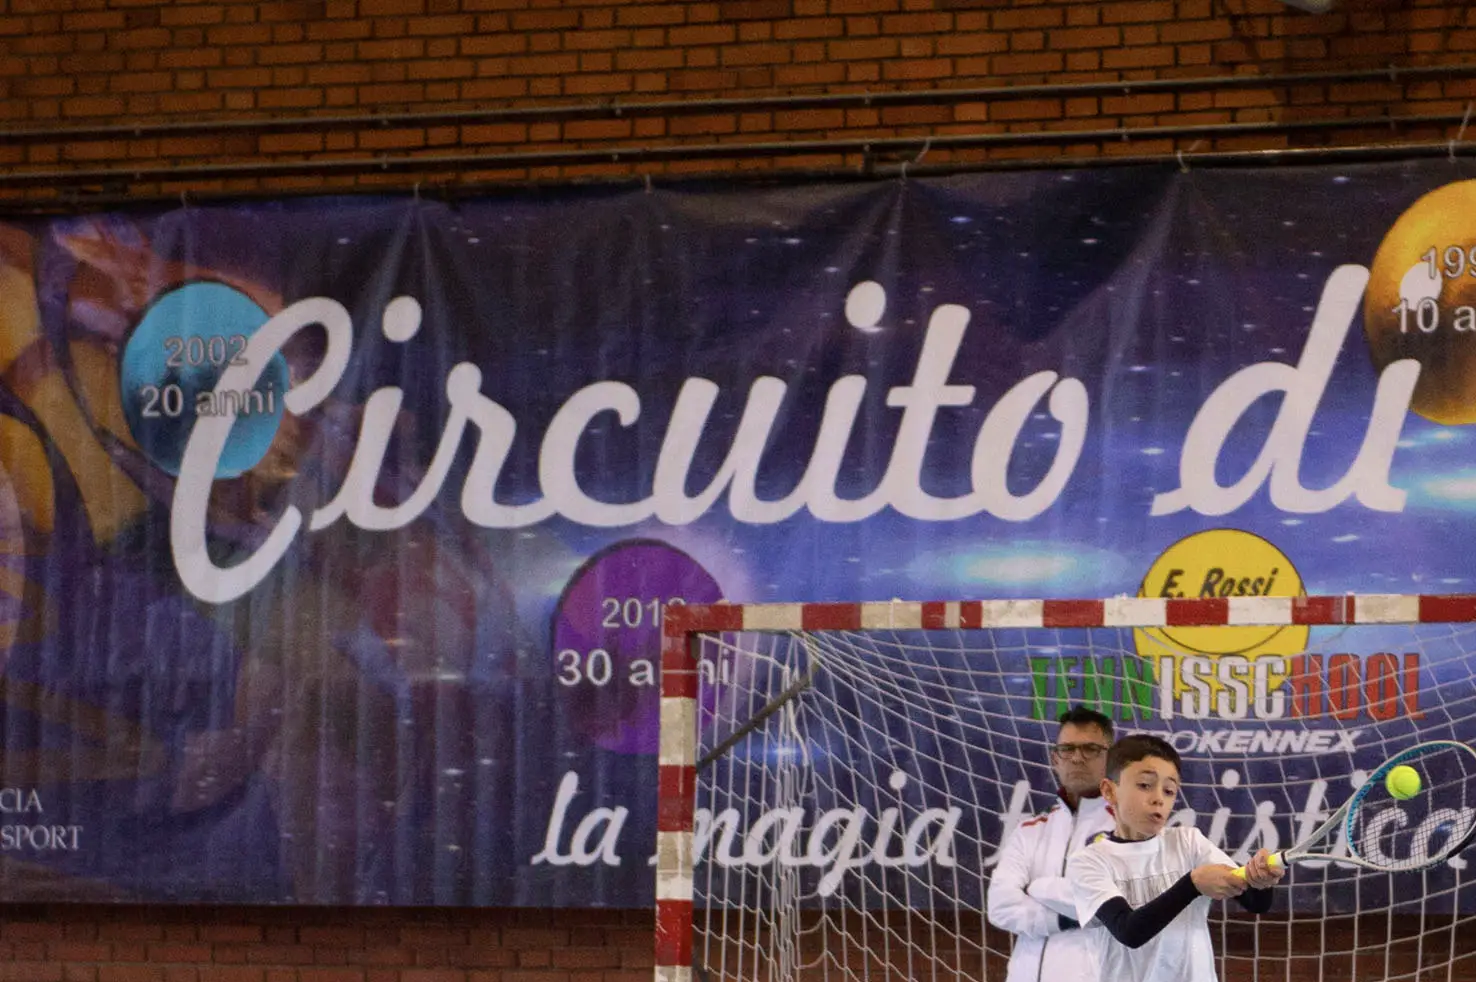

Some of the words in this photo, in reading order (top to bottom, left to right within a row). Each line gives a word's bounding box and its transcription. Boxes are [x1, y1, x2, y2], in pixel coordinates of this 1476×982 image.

[1391, 297, 1440, 334] 10
[165, 335, 249, 368] 2002
[140, 384, 184, 418] 20
[196, 382, 276, 418] anni
[171, 280, 1089, 604] Circuito
[1151, 262, 1442, 515] di
[1200, 567, 1279, 598] Rossi
[602, 597, 686, 628] 201
[557, 648, 613, 687] 30
[628, 648, 729, 687] ani
[530, 769, 629, 867] la
[0, 824, 84, 851] SPORT
